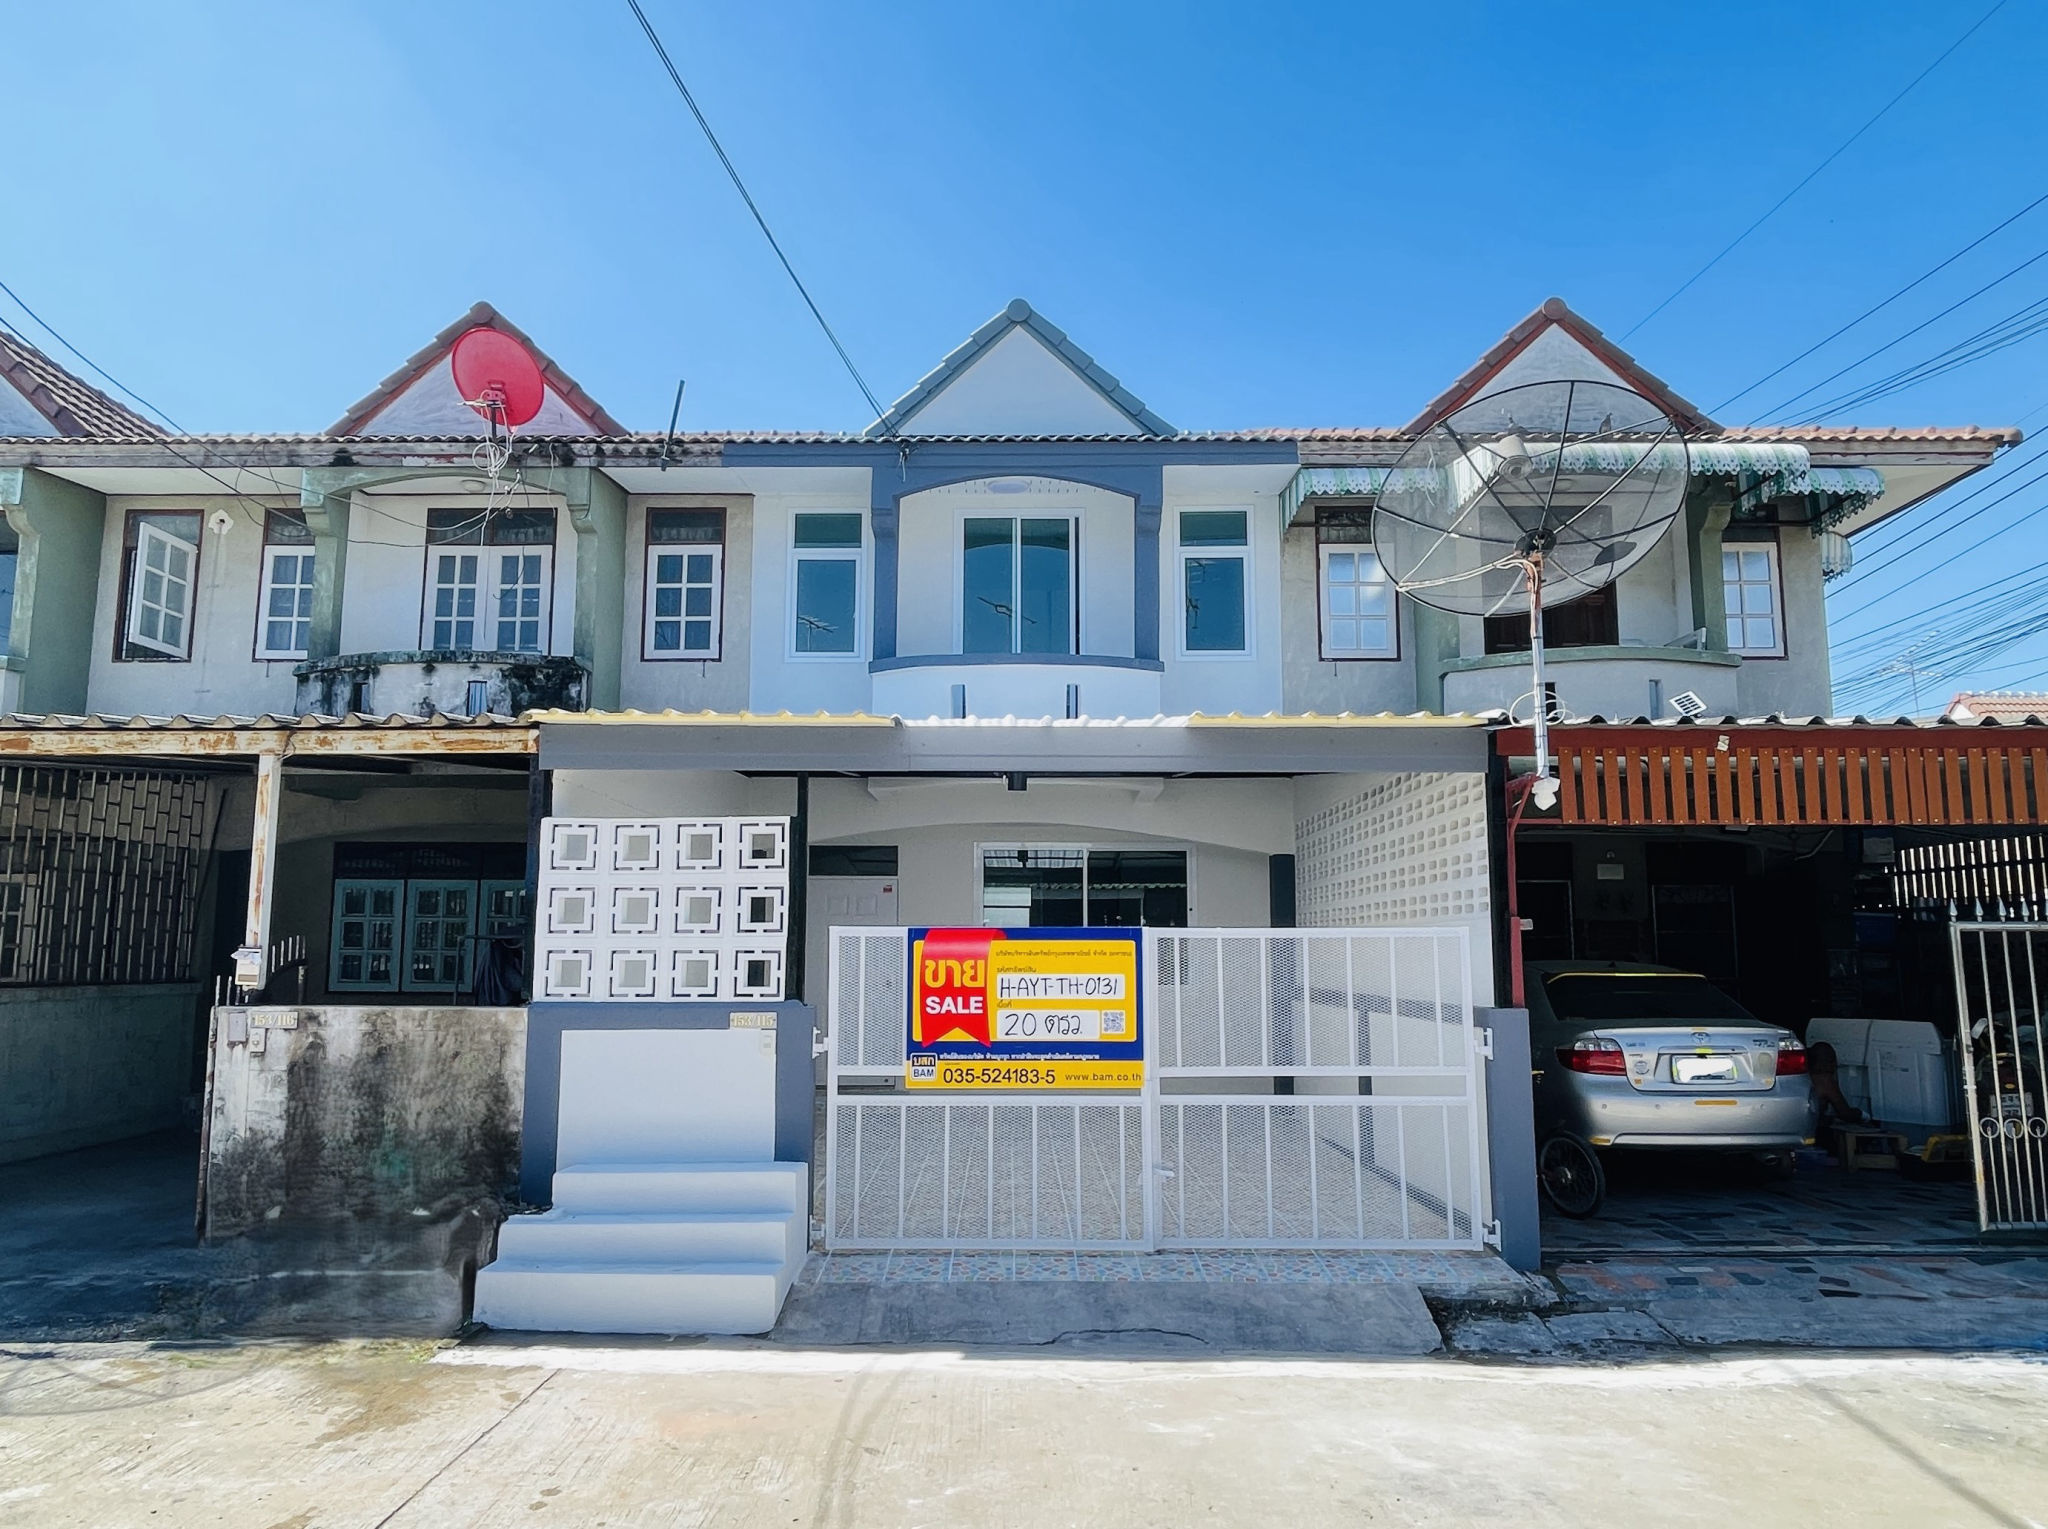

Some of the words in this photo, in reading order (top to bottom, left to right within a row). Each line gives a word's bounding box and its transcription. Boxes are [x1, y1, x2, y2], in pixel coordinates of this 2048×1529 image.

[925, 959, 985, 988] ขาย
[925, 996, 984, 1014] SALE
[1004, 1012, 1037, 1037] 20
[913, 1068, 934, 1078] BAM
[943, 1067, 1056, 1084] 035-524183-5
[1065, 1073, 1141, 1081] www.bam.co.th
